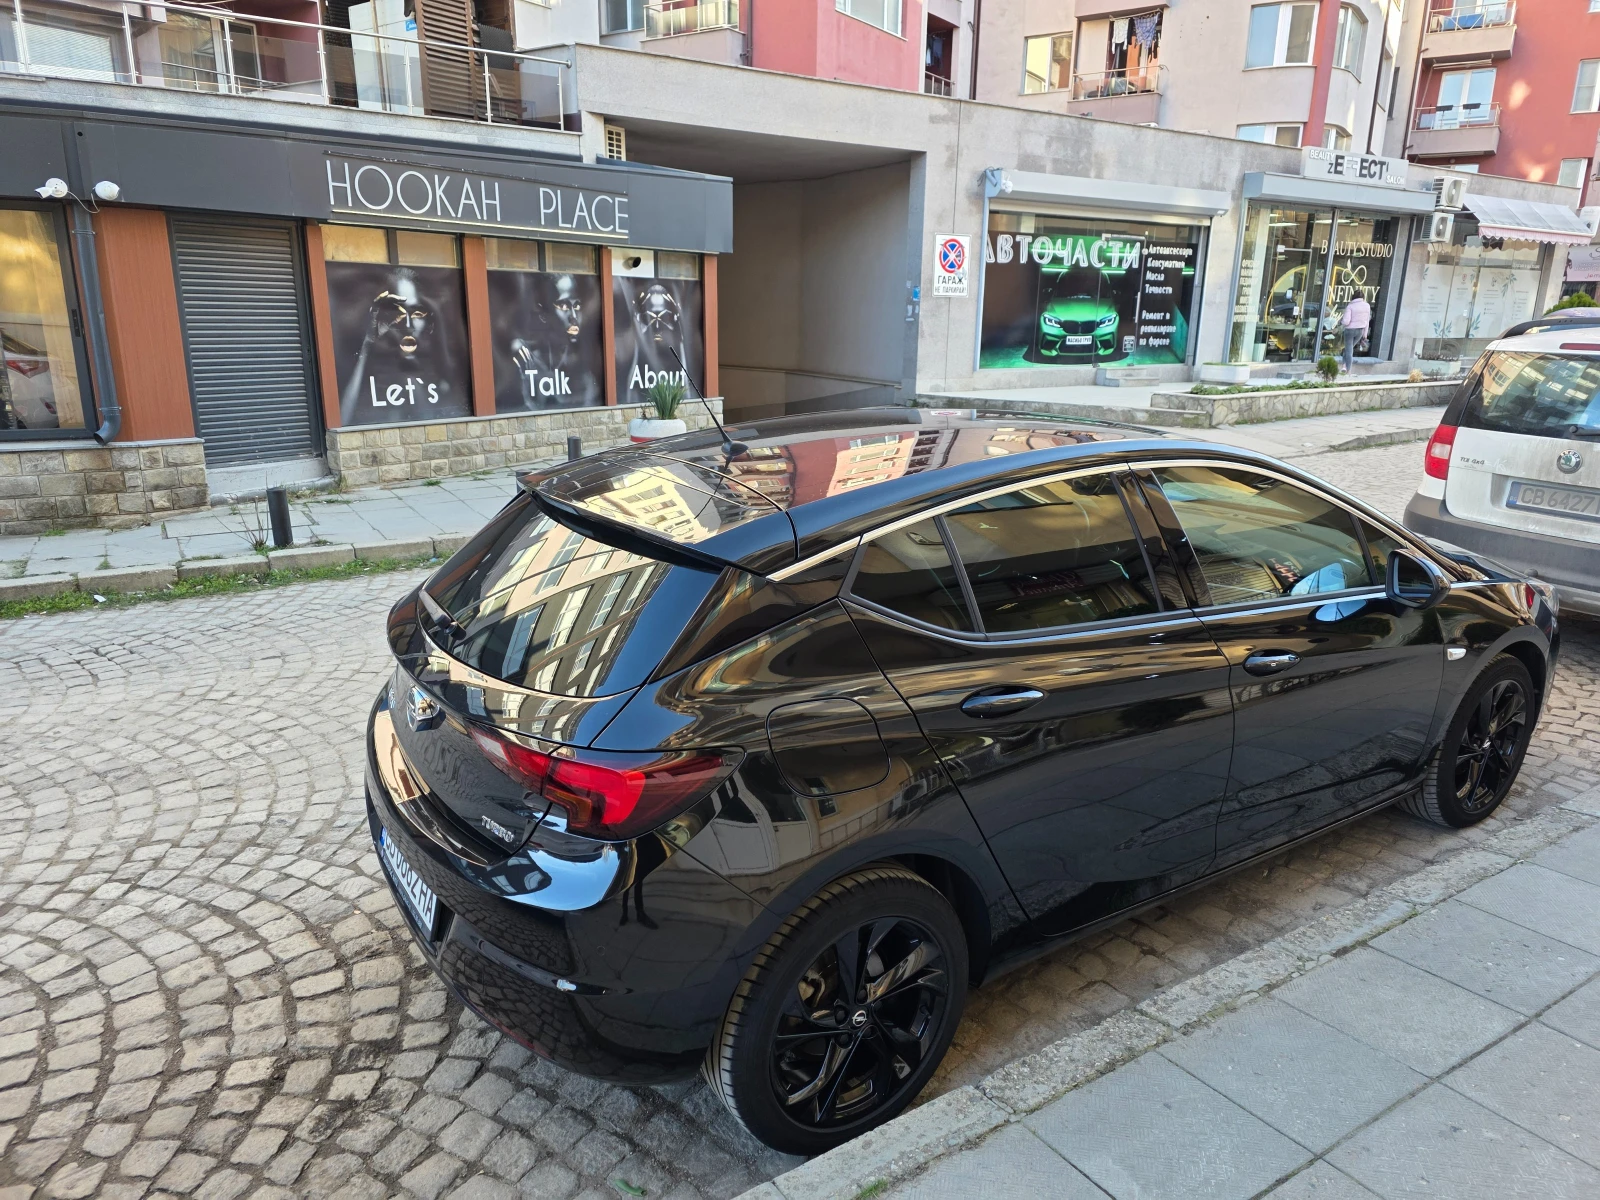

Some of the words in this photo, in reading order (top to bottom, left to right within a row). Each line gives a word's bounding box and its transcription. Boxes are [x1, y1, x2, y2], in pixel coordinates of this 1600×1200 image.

[1310, 150, 1335, 161] BEAUTY
[1386, 175, 1405, 185] SALON
[326, 160, 501, 221] HOOKAH
[539, 187, 629, 234] PLACE
[1320, 239, 1360, 256] BAUTY
[1360, 243, 1393, 258] STUDIO
[937, 275, 964, 285] ГАРАЖ
[524, 368, 572, 397] Talk
[629, 364, 687, 389] About
[481, 815, 515, 843] TURBO
